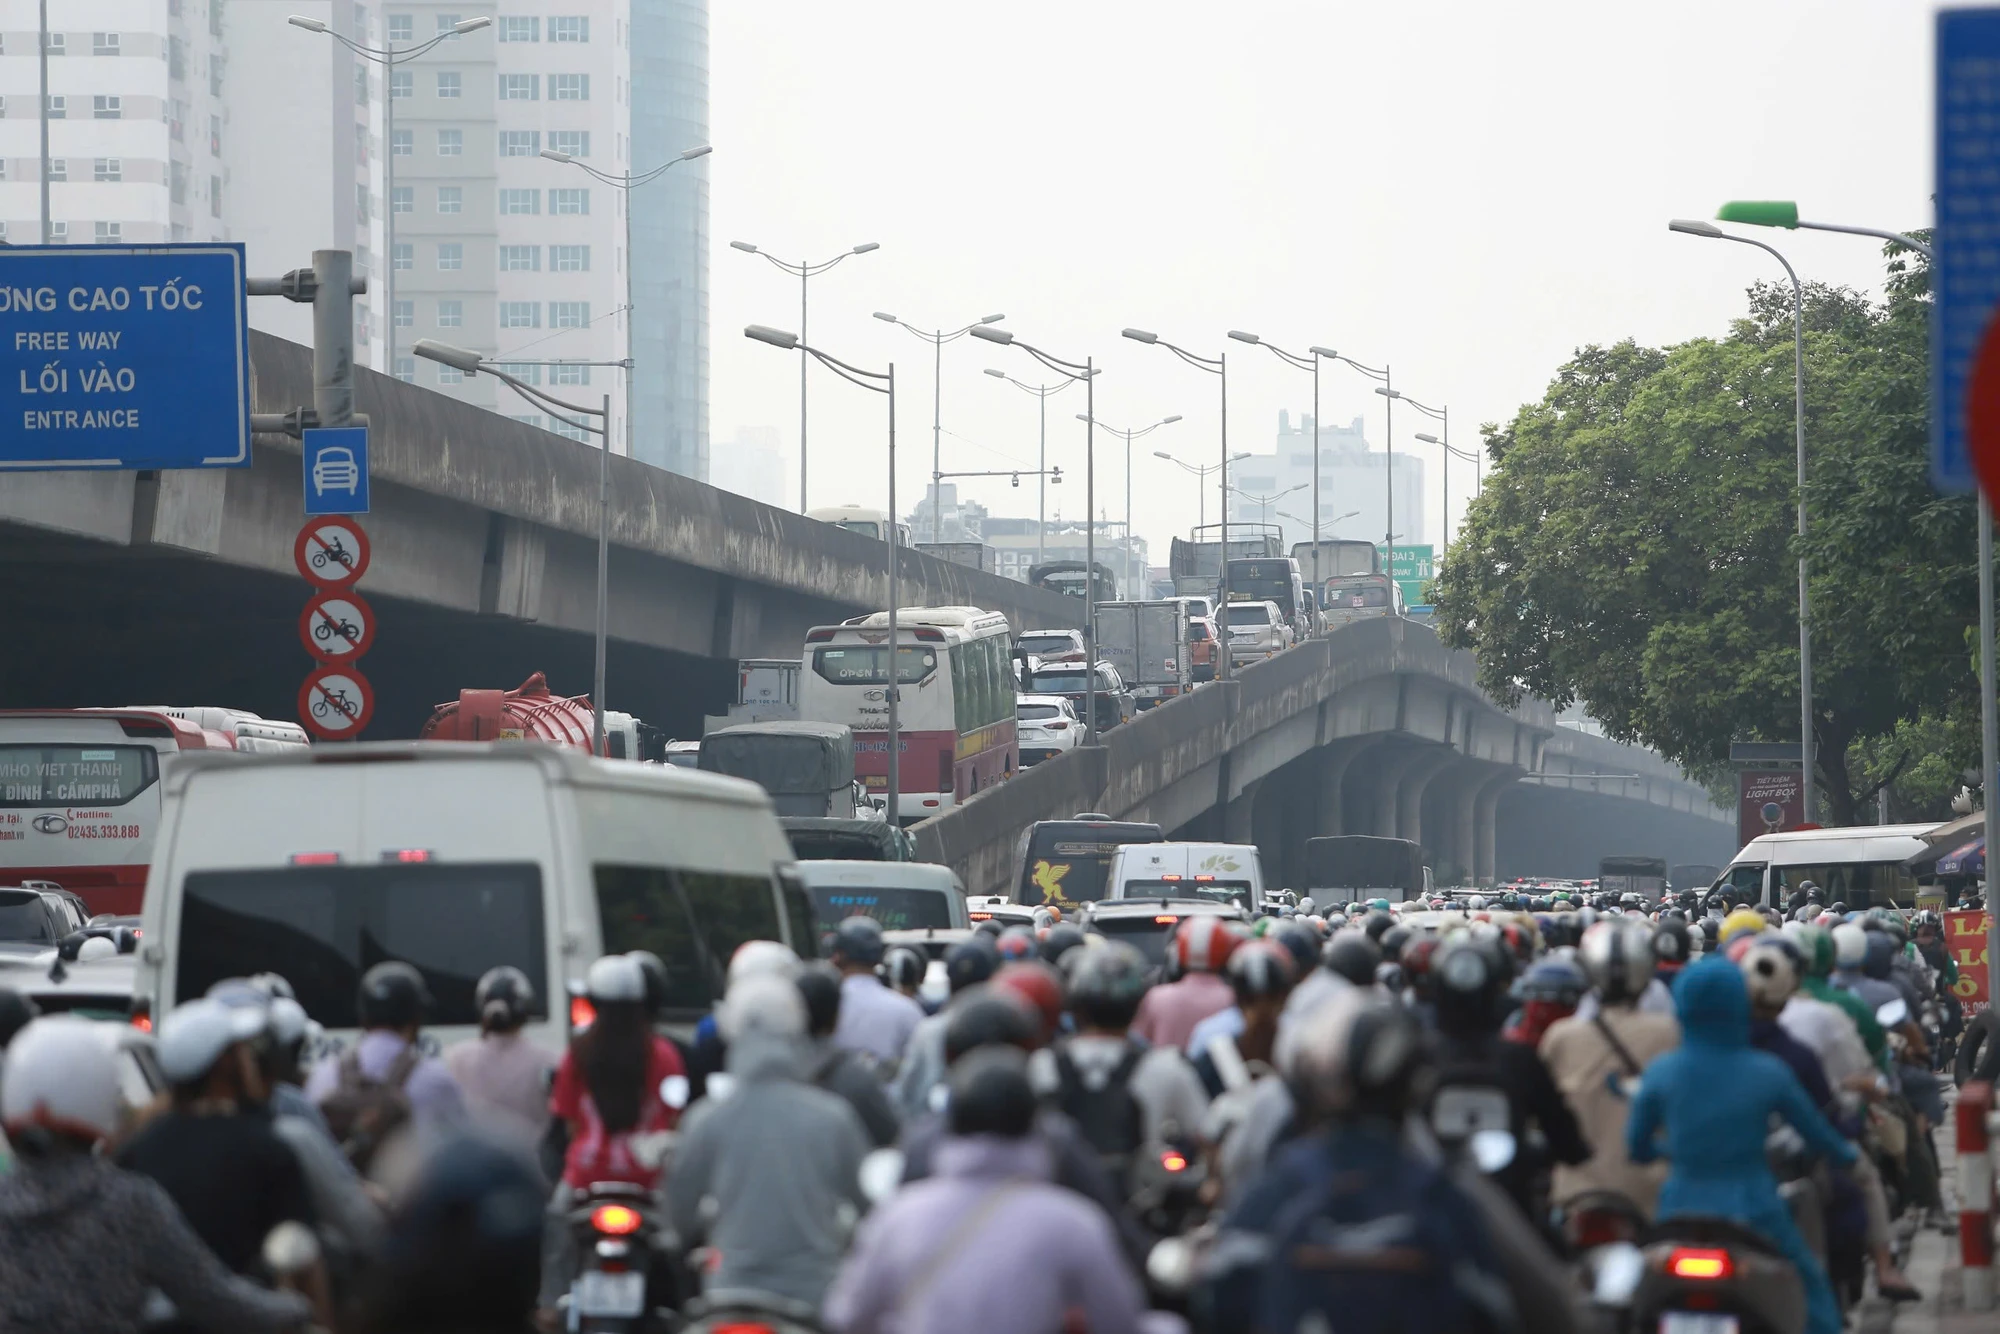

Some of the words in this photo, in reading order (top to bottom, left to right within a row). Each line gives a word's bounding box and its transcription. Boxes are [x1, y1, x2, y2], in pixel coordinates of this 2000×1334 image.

[68, 286, 130, 311] CAO
[139, 276, 203, 311] TỐC
[15, 332, 69, 351] FREE
[78, 331, 121, 350] WAY
[20, 360, 68, 394] LỐI
[79, 361, 135, 393] VÀO
[24, 409, 139, 430] ENTRANCE
[1408, 551, 1414, 560] 3
[839, 668, 872, 677] OPEN
[877, 668, 910, 677] TUR
[36, 762, 67, 777] VIET
[71, 762, 122, 777] THANH
[5, 782, 42, 801] ĐÌNH
[1746, 789, 1774, 798] LIGHT
[1775, 787, 1796, 796] BOX
[76, 810, 113, 820] Hotline:
[68, 825, 140, 839] 02435.333.888
[1952, 973, 1978, 997] Ô
